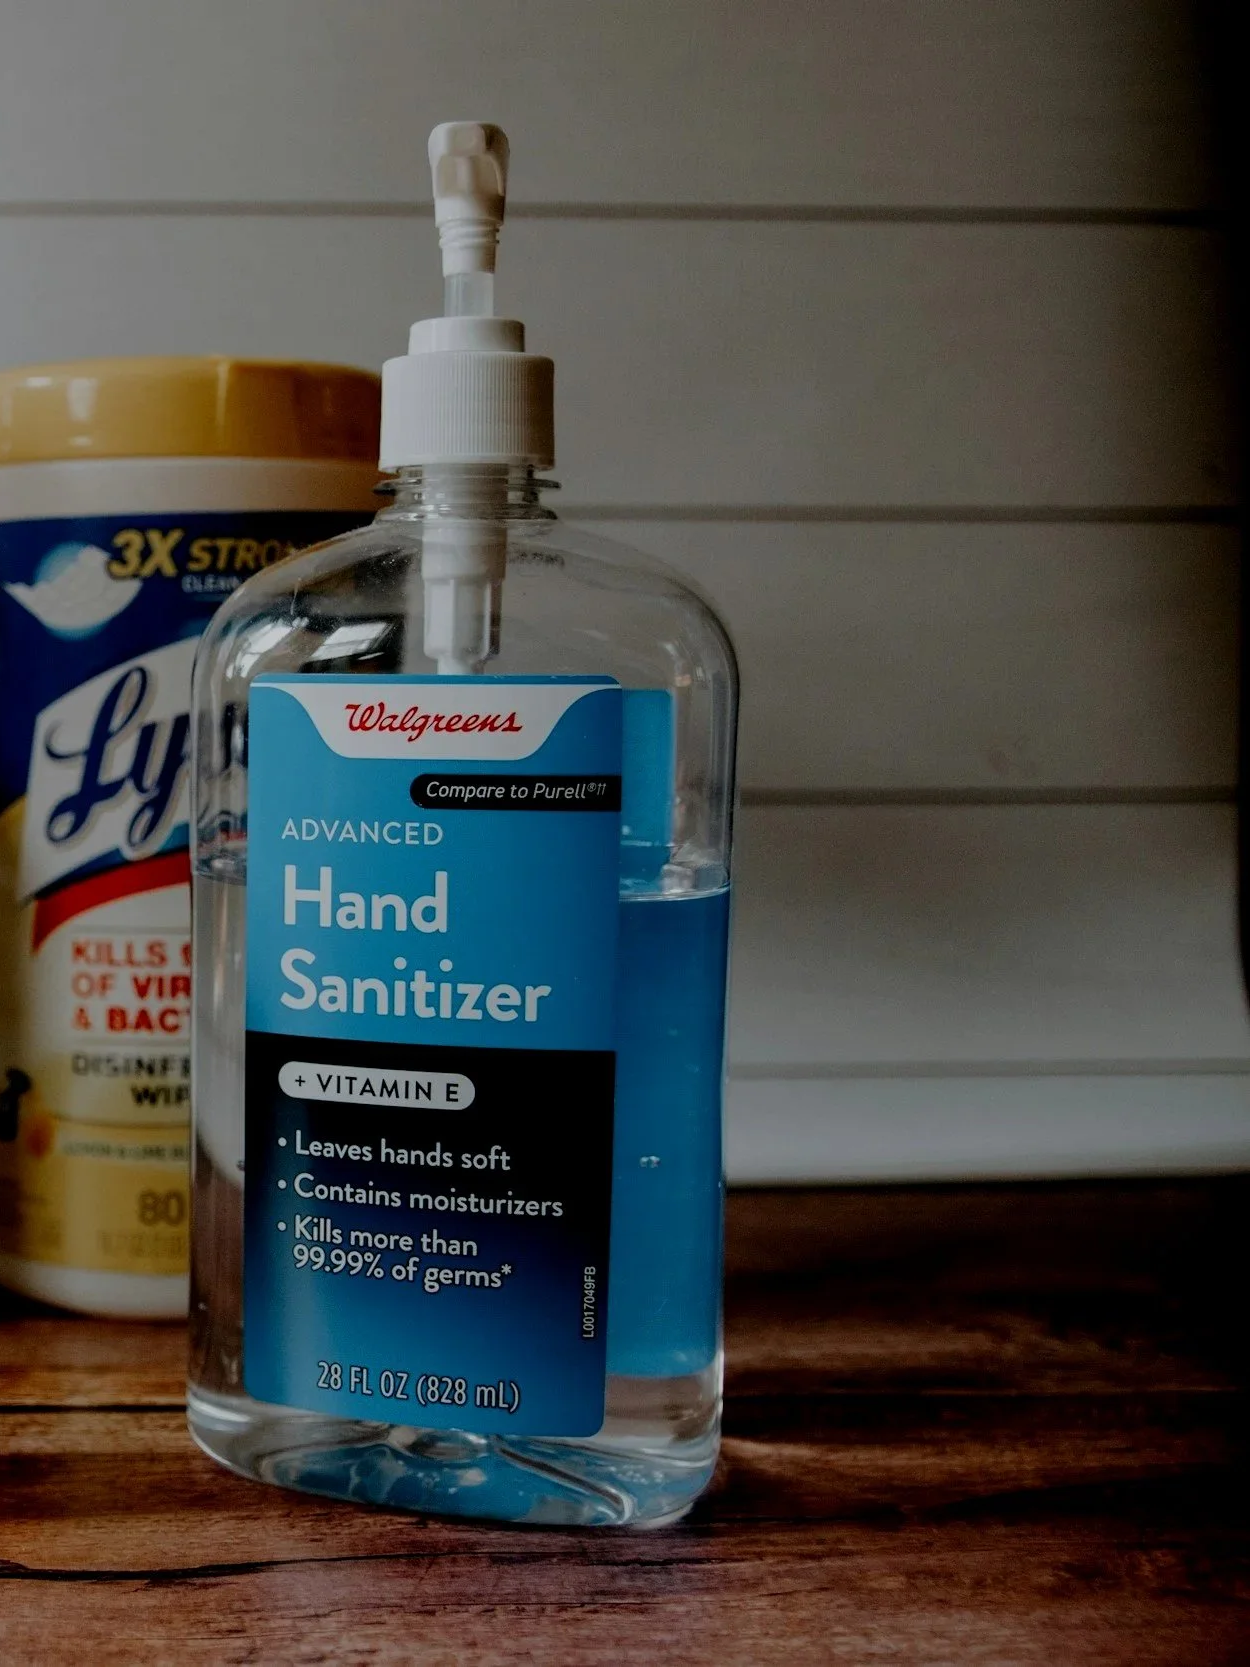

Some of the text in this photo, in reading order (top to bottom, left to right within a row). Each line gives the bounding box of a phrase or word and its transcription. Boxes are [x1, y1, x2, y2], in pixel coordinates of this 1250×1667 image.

[109, 528, 184, 577] 3X
[345, 702, 522, 742] Walgreens
[426, 781, 505, 802] Compare
[510, 783, 528, 799] to
[281, 818, 443, 846] ADVANCED
[284, 864, 448, 933] Hand
[72, 941, 167, 966] KILLS
[72, 972, 115, 997] OF
[280, 947, 552, 1022] Sanitizer
[72, 1007, 190, 1032] & BAC
[295, 1073, 459, 1103] + VITAMIN E
[295, 1130, 511, 1171] Leaves hands soft
[139, 1189, 185, 1226] 80
[294, 1172, 564, 1217] Contains moisturizers
[294, 1215, 478, 1256] Kills more than
[292, 1243, 384, 1279] 99.99%
[391, 1257, 419, 1281] of
[582, 1265, 596, 1339] L0017049FB
[317, 1361, 520, 1414] 28 FL OZ (828 mL)
